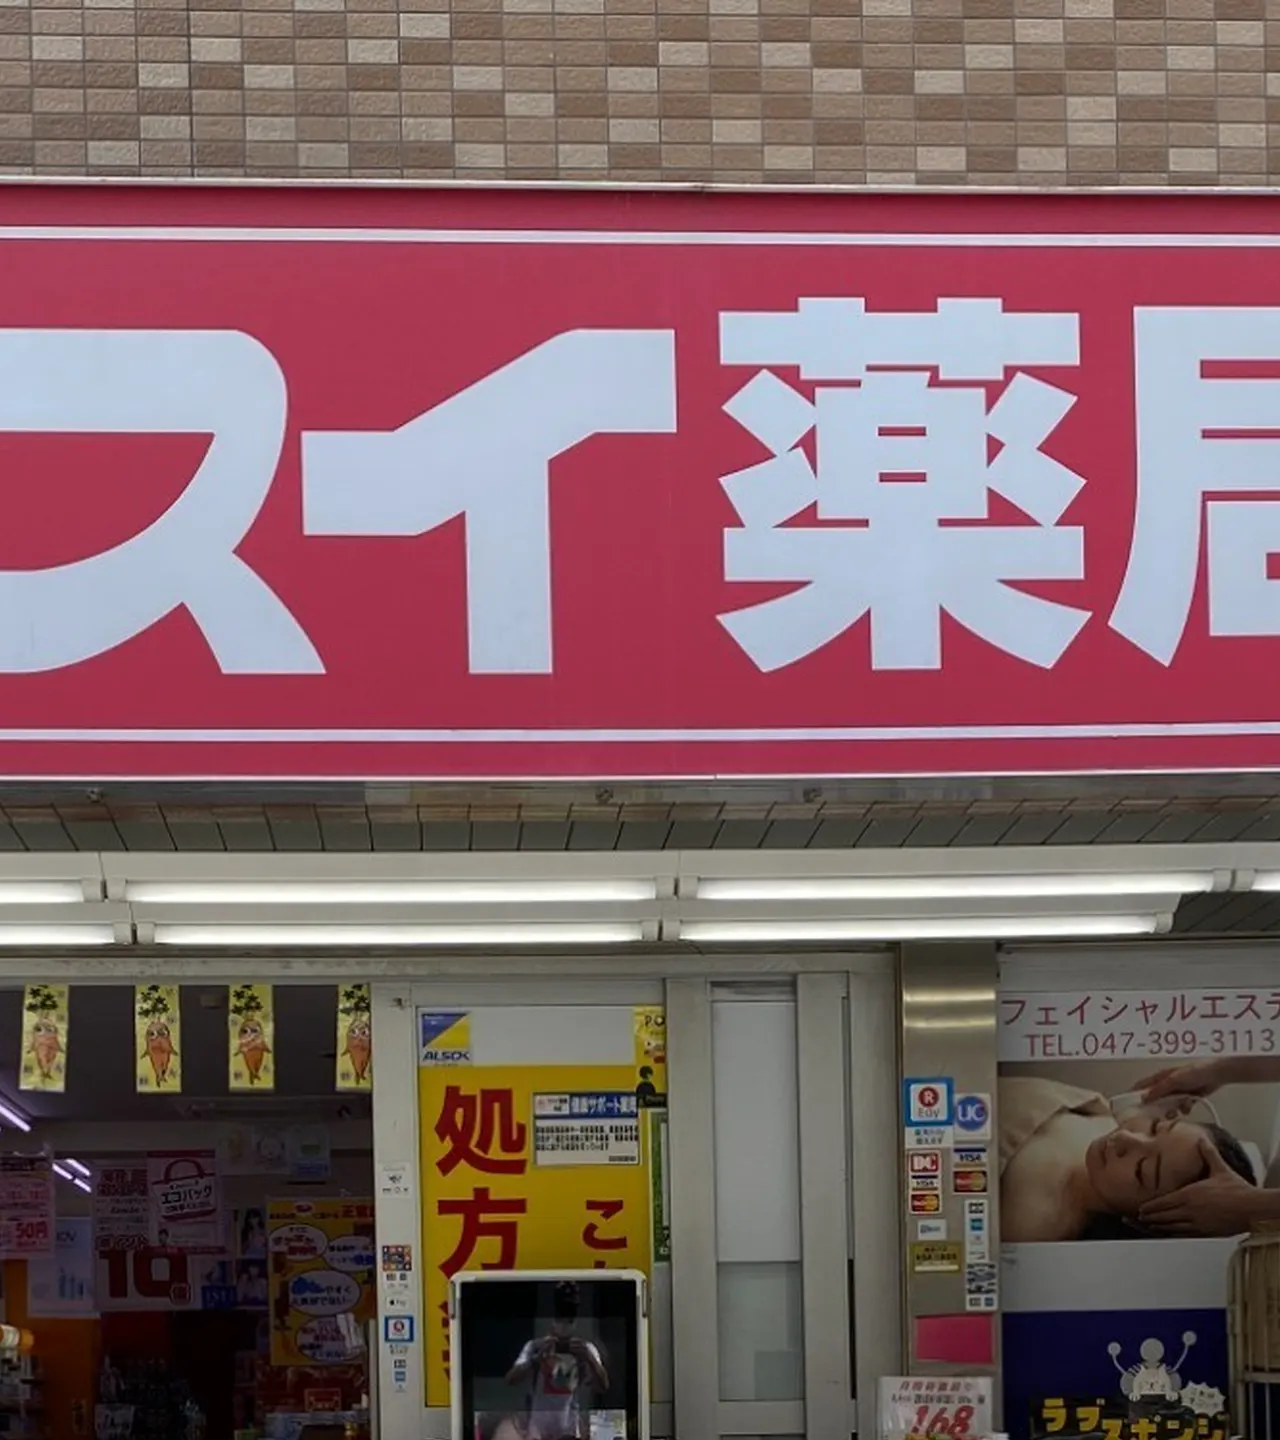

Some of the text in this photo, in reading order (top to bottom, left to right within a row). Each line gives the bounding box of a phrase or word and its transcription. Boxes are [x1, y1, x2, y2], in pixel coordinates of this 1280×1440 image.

[1024, 1028, 1277, 1058] TEL.047-399-3113
[422, 1050, 470, 1063] ALSOK
[957, 1105, 988, 1122] UC
[912, 1154, 937, 1171] DC
[434, 1085, 528, 1378] 処方
